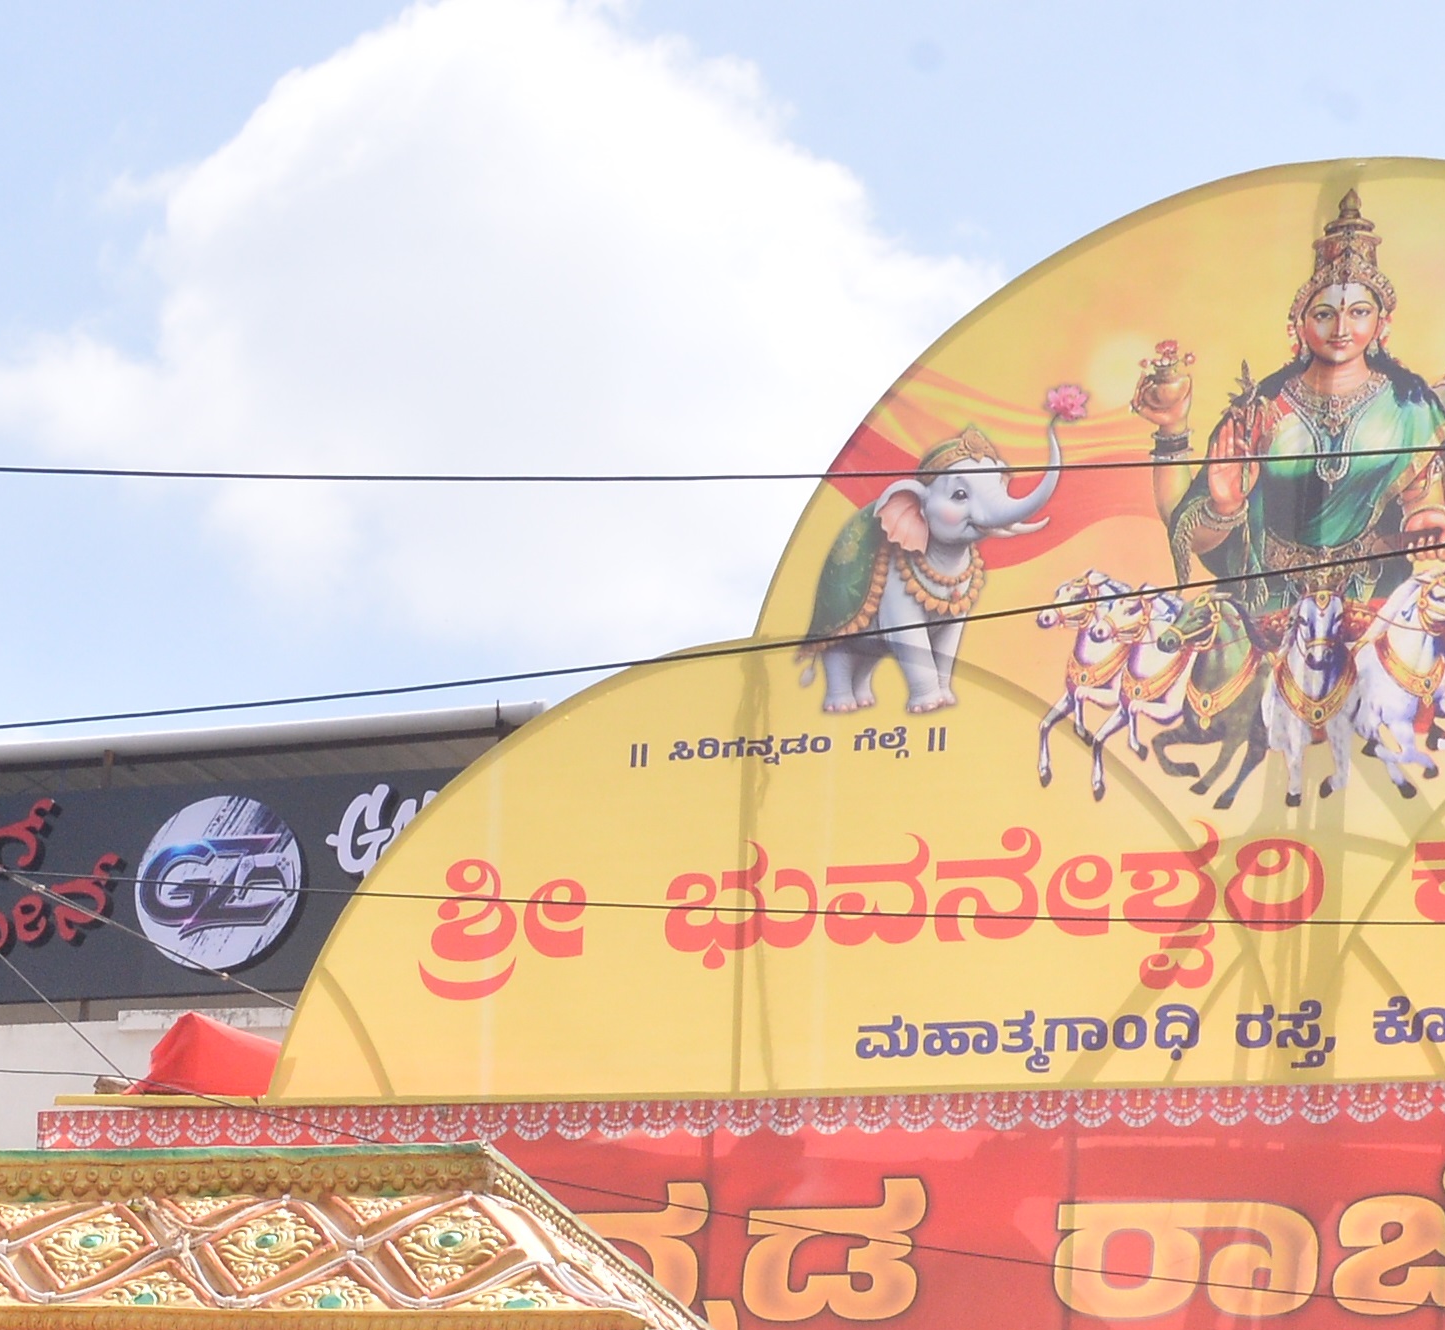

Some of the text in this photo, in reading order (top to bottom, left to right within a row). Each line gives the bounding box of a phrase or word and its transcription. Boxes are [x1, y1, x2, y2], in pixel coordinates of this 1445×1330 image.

[667, 732, 832, 765] ಸಿರಿಗನ್ನಡಂ
[418, 858, 586, 1001] ಶ್ರೀ
[664, 821, 1326, 991] ಭುವನೇಶ್ವರಿ
[855, 1003, 1200, 1073] ಮಹಾತ್ಮಗಾಂಧಿ
[1235, 999, 1337, 1069] ರಸ್ತೆ
